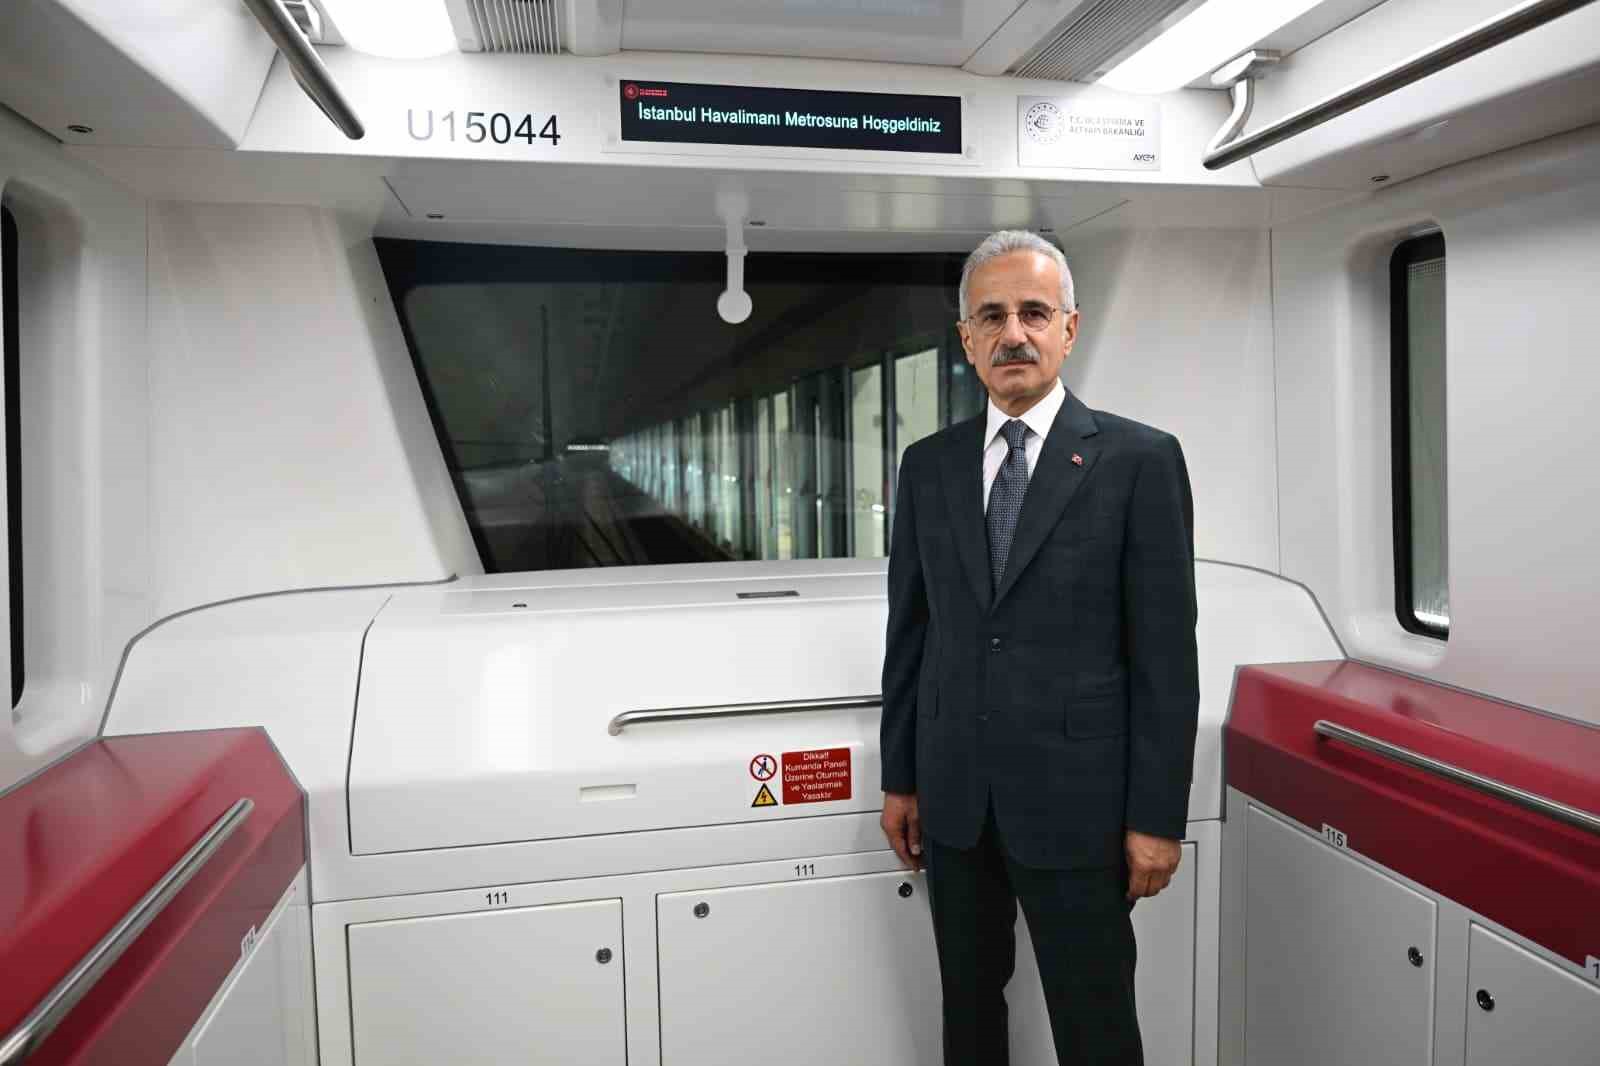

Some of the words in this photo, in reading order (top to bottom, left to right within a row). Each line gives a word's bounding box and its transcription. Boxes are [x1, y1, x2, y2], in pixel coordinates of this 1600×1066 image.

[638, 102, 696, 122] İstanbul
[701, 108, 780, 126] Havalimanı
[785, 112, 858, 129] Metrosuna
[862, 115, 941, 134] Hoşgeldiniz
[1134, 119, 1145, 127] VE
[407, 109, 561, 146] U15044
[785, 763, 822, 772] Kumanda
[784, 772, 814, 782] Üzerine
[815, 770, 849, 780] Oturmak
[801, 781, 843, 790] Yaslanmak
[1327, 828, 1344, 847] 115
[794, 863, 815, 877] 111
[485, 892, 508, 905] 111
